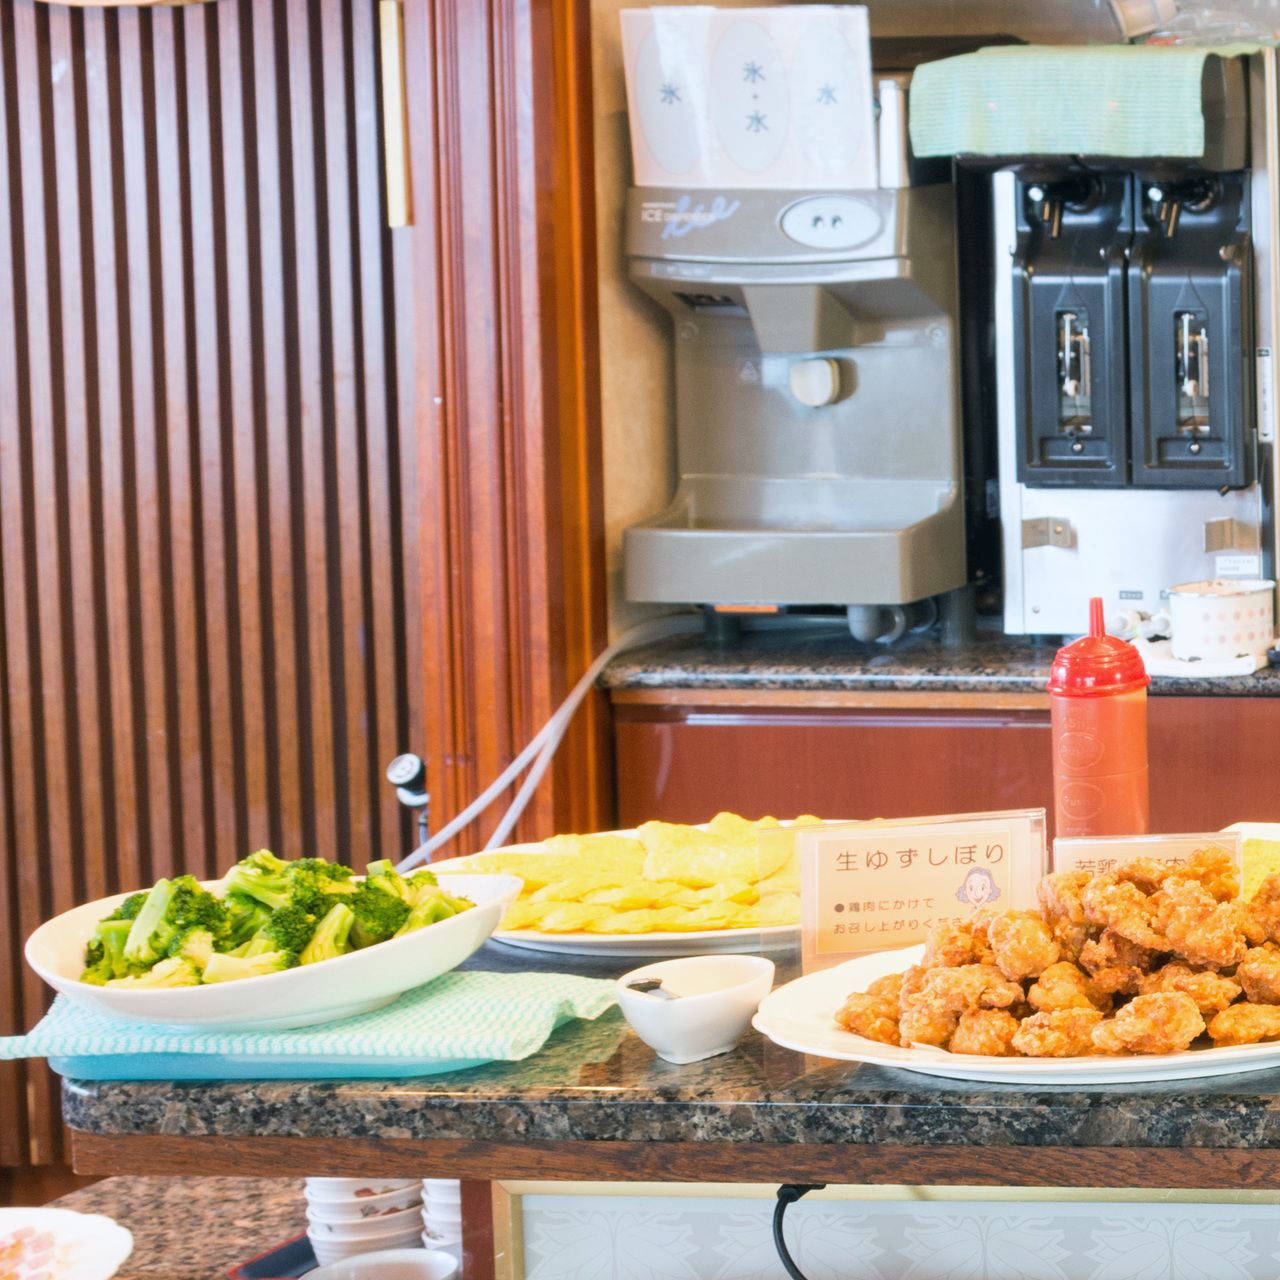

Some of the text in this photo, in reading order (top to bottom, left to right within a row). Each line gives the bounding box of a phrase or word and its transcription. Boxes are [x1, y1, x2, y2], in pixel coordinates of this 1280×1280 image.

[641, 209, 662, 222] ICE
[835, 844, 1004, 873] 生ゆずしぼり
[848, 897, 936, 914] 鶏肉にかけて
[833, 916, 963, 935] お召し上がりくださ
